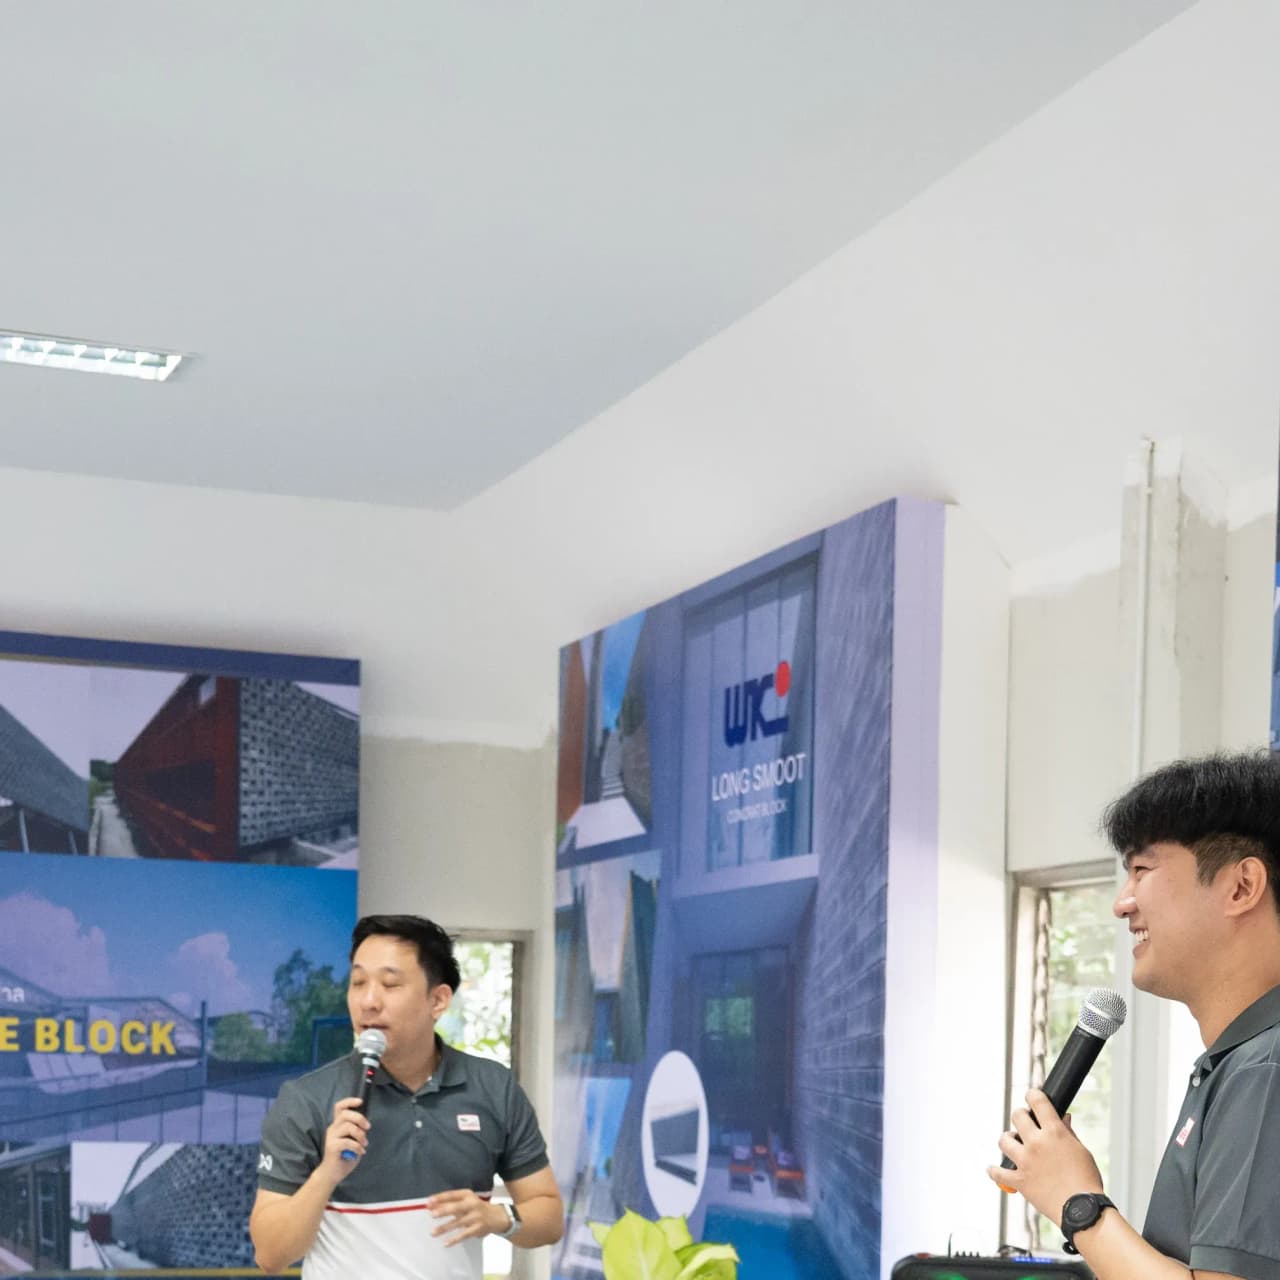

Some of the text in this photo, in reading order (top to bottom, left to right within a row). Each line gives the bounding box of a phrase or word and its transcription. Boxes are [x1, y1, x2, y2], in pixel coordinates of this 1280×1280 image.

[712, 753, 806, 801] LONG SMOOT
[34, 1018, 177, 1056] BLOCK
